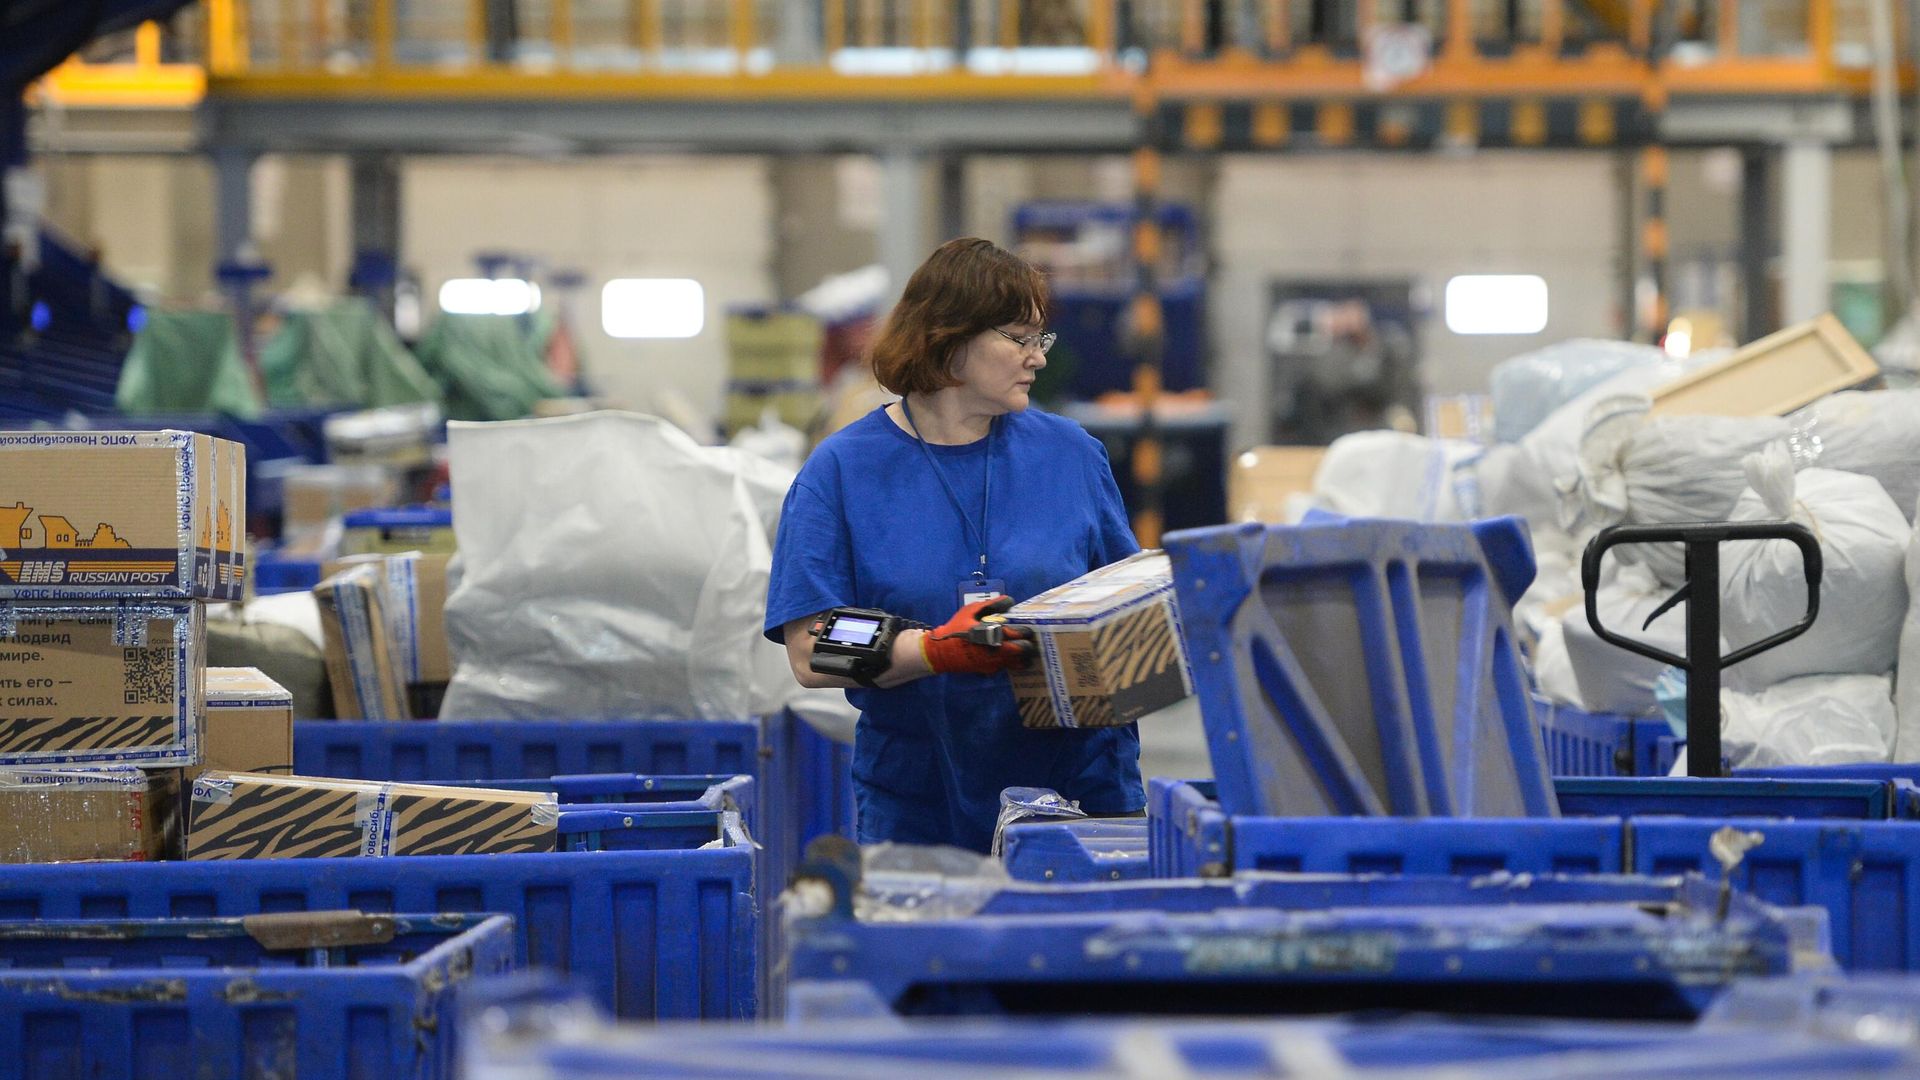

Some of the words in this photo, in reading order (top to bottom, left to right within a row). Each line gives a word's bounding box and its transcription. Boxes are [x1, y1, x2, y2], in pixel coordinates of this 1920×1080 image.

[0, 435, 97, 446] Новосибирской
[101, 436, 137, 445] УФПС
[20, 561, 66, 582] EMS
[69, 572, 128, 583] RUSSIAN
[130, 572, 170, 583] POST
[13, 590, 49, 599] УФПС
[12, 633, 71, 645] подвид
[0, 652, 44, 664] мире.
[27, 678, 53, 688] его
[8, 696, 57, 706] силах.
[22, 776, 72, 786] области
[366, 809, 380, 857] овосиб
